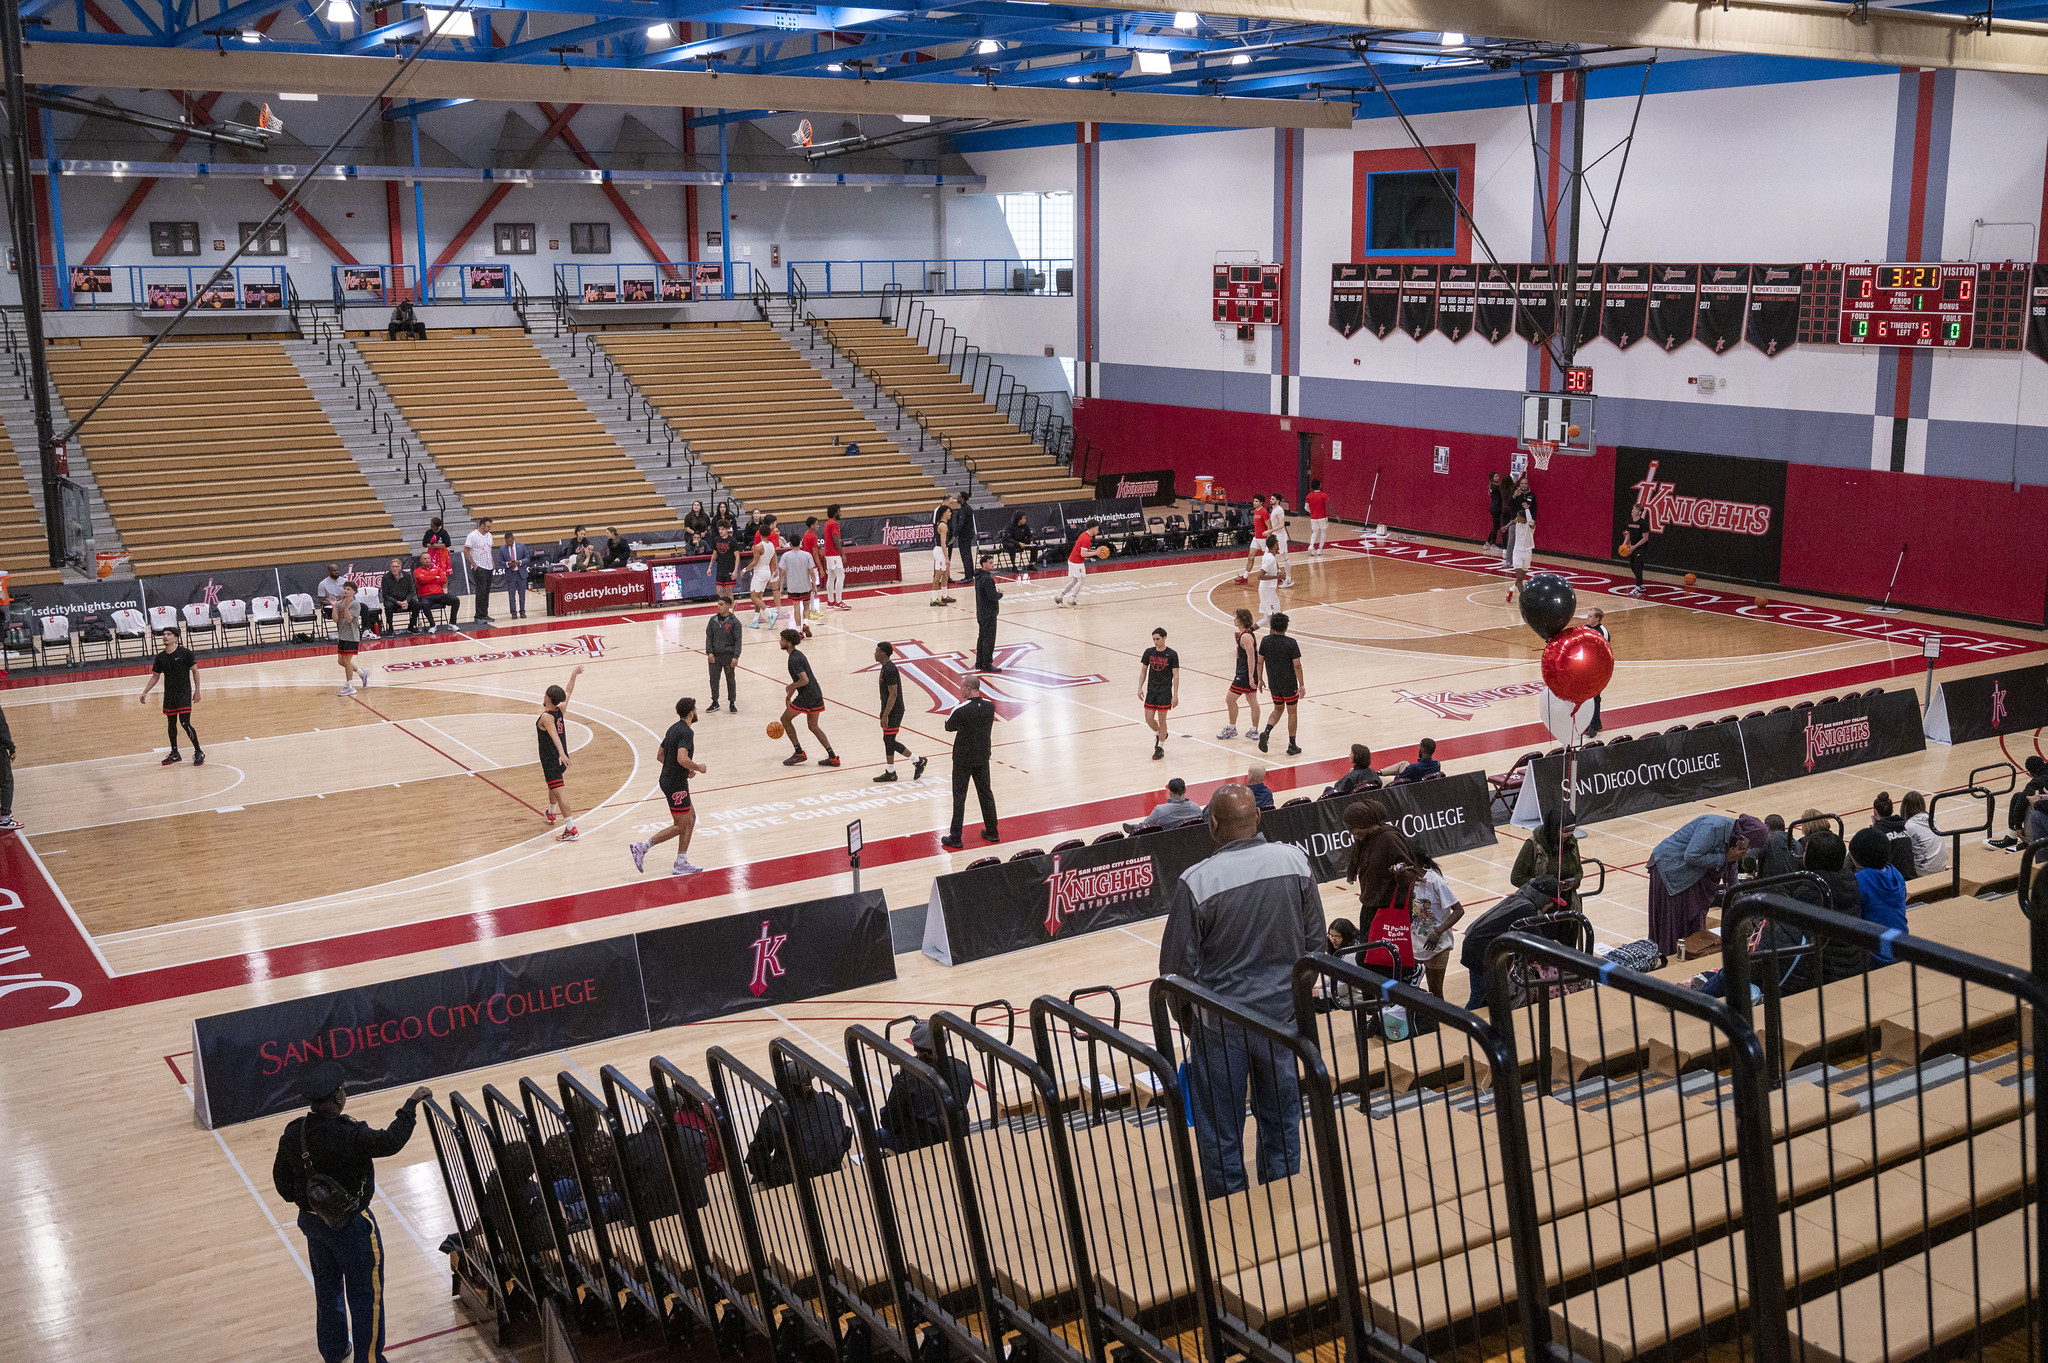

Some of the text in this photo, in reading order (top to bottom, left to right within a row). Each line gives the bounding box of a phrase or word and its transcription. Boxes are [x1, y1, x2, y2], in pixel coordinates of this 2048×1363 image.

[1849, 267, 1872, 276] HOME
[1891, 268, 1936, 287] 3:21
[1943, 267, 1975, 276] VISITOR
[1860, 280, 1872, 298] 0
[1960, 280, 1971, 299] 0
[1855, 301, 1874, 309] BONUS
[1858, 321, 1868, 336] 0
[1878, 321, 1887, 336] 6
[1921, 322, 1930, 338] 6
[1950, 323, 1960, 339] 0
[1568, 371, 1586, 389] 30
[1116, 475, 1158, 498] KNIGHTS
[1630, 460, 1772, 536] KNIGHTS
[882, 519, 934, 545] KNIGHTS
[1330, 539, 1451, 559] SAN
[202, 577, 223, 605] K
[564, 583, 645, 602] @sdcityknights
[1608, 583, 1746, 606] CITY
[1735, 604, 2027, 654] COLLEGE
[1992, 680, 2007, 729] K
[557, 717, 563, 733] 6
[1802, 711, 1870, 772] KNIGHTS
[1825, 741, 1869, 755] ATHLETICS
[1594, 769, 1636, 795] DIEGO
[1637, 762, 1666, 785] CITY
[1668, 752, 1721, 780] COLLEGE
[709, 801, 796, 821] MENS
[797, 774, 953, 806] BASKETBAL
[695, 787, 953, 838] STATE CHAMPIONS
[1311, 830, 1356, 857] DIEG
[1402, 806, 1466, 838] COLLEGE
[1078, 868, 1091, 876] SAN
[1111, 861, 1125, 869] CITY
[1125, 855, 1151, 865] COLLEGE
[1042, 854, 1153, 936] KNIGHTS
[1078, 888, 1151, 912] ATHLETICS
[749, 920, 787, 997] K
[260, 978, 598, 1075] SAN DIEGO CITY COLLEGE
